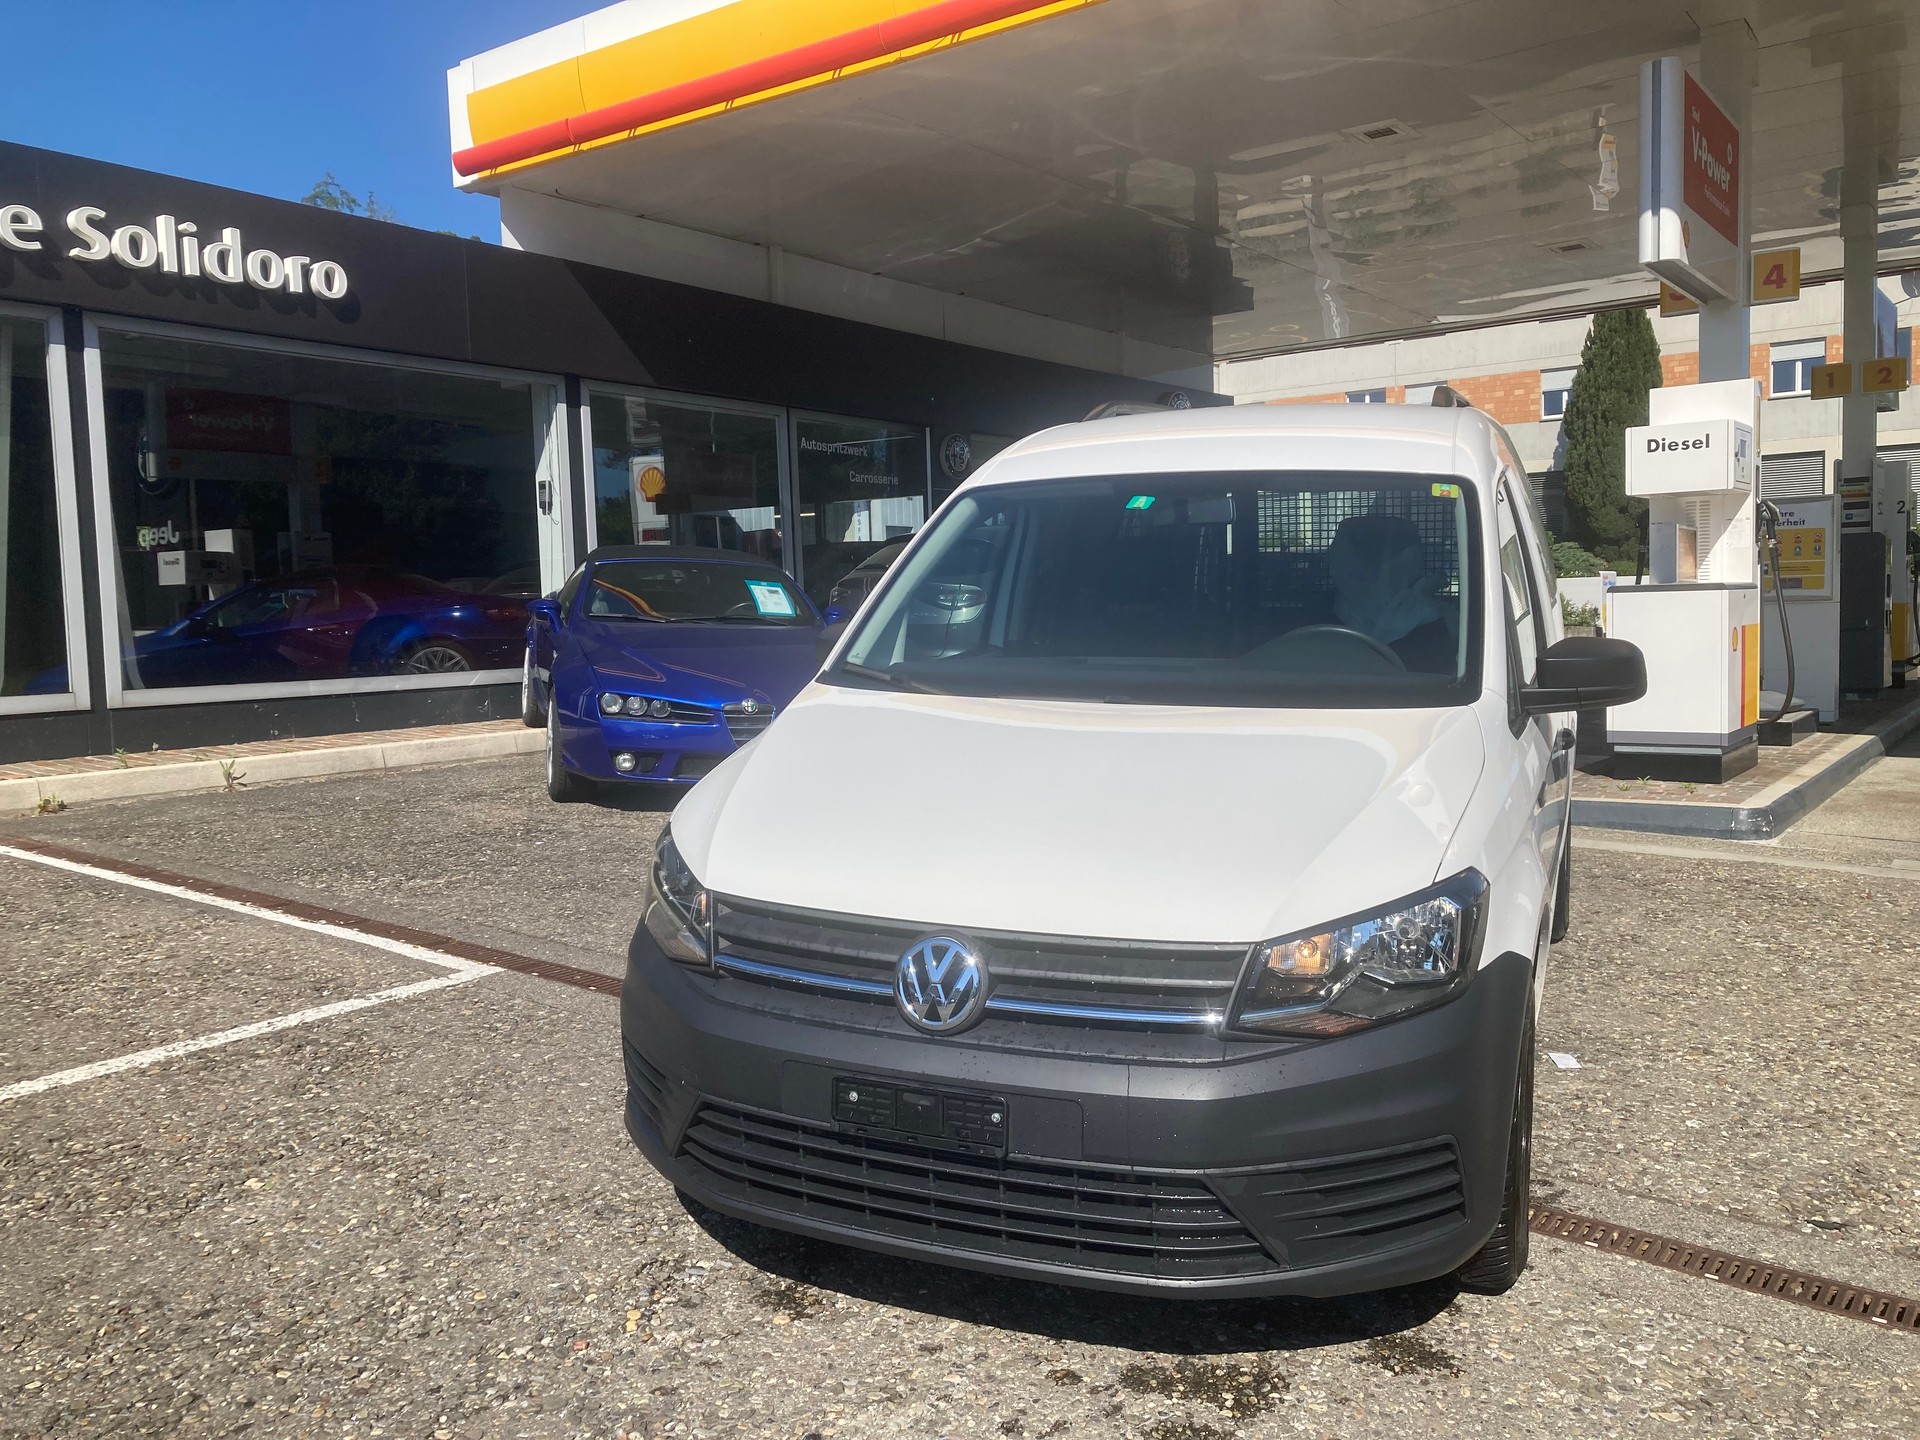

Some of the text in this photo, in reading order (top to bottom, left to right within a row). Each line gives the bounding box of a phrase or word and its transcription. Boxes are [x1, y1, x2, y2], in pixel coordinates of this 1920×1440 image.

[1692, 126, 1731, 193] V-Power
[66, 206, 348, 299] Solidoro
[1762, 263, 1787, 290] 4
[1826, 372, 1834, 389] 1
[1876, 367, 1892, 384] 2
[800, 437, 868, 456] Autospritzwerk
[1647, 433, 1710, 453] Diesel
[849, 471, 899, 485] Carrosserie
[1896, 500, 1906, 514] 2
[898, 936, 981, 1031] VW
